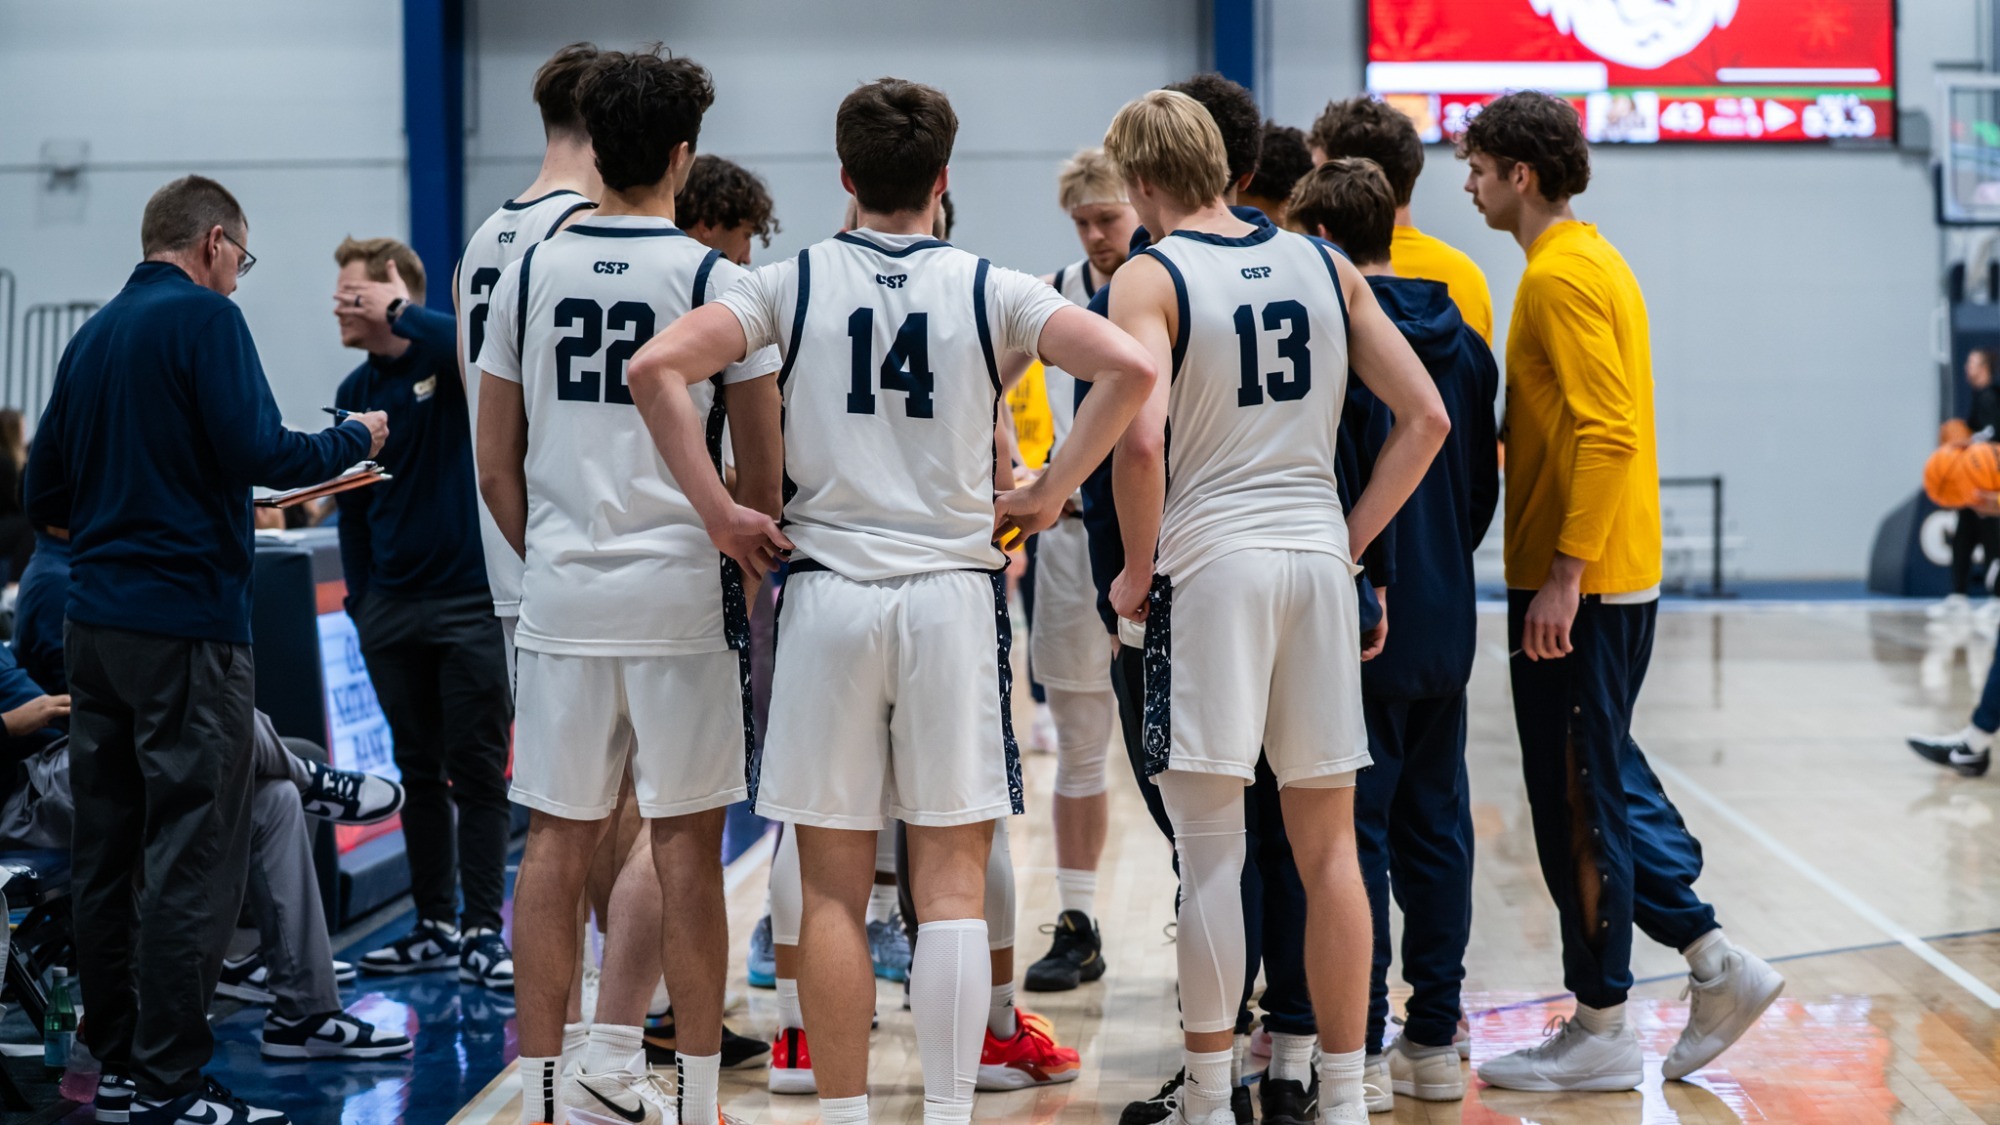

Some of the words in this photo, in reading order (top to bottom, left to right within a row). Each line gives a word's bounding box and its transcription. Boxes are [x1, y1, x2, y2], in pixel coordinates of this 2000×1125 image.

[1660, 101, 1705, 133] 43
[593, 261, 629, 274] CSP
[875, 273, 908, 289] CSP
[1240, 266, 1272, 280] CSP
[554, 297, 655, 405] 22
[847, 307, 934, 419] 14
[1233, 299, 1311, 407] 13
